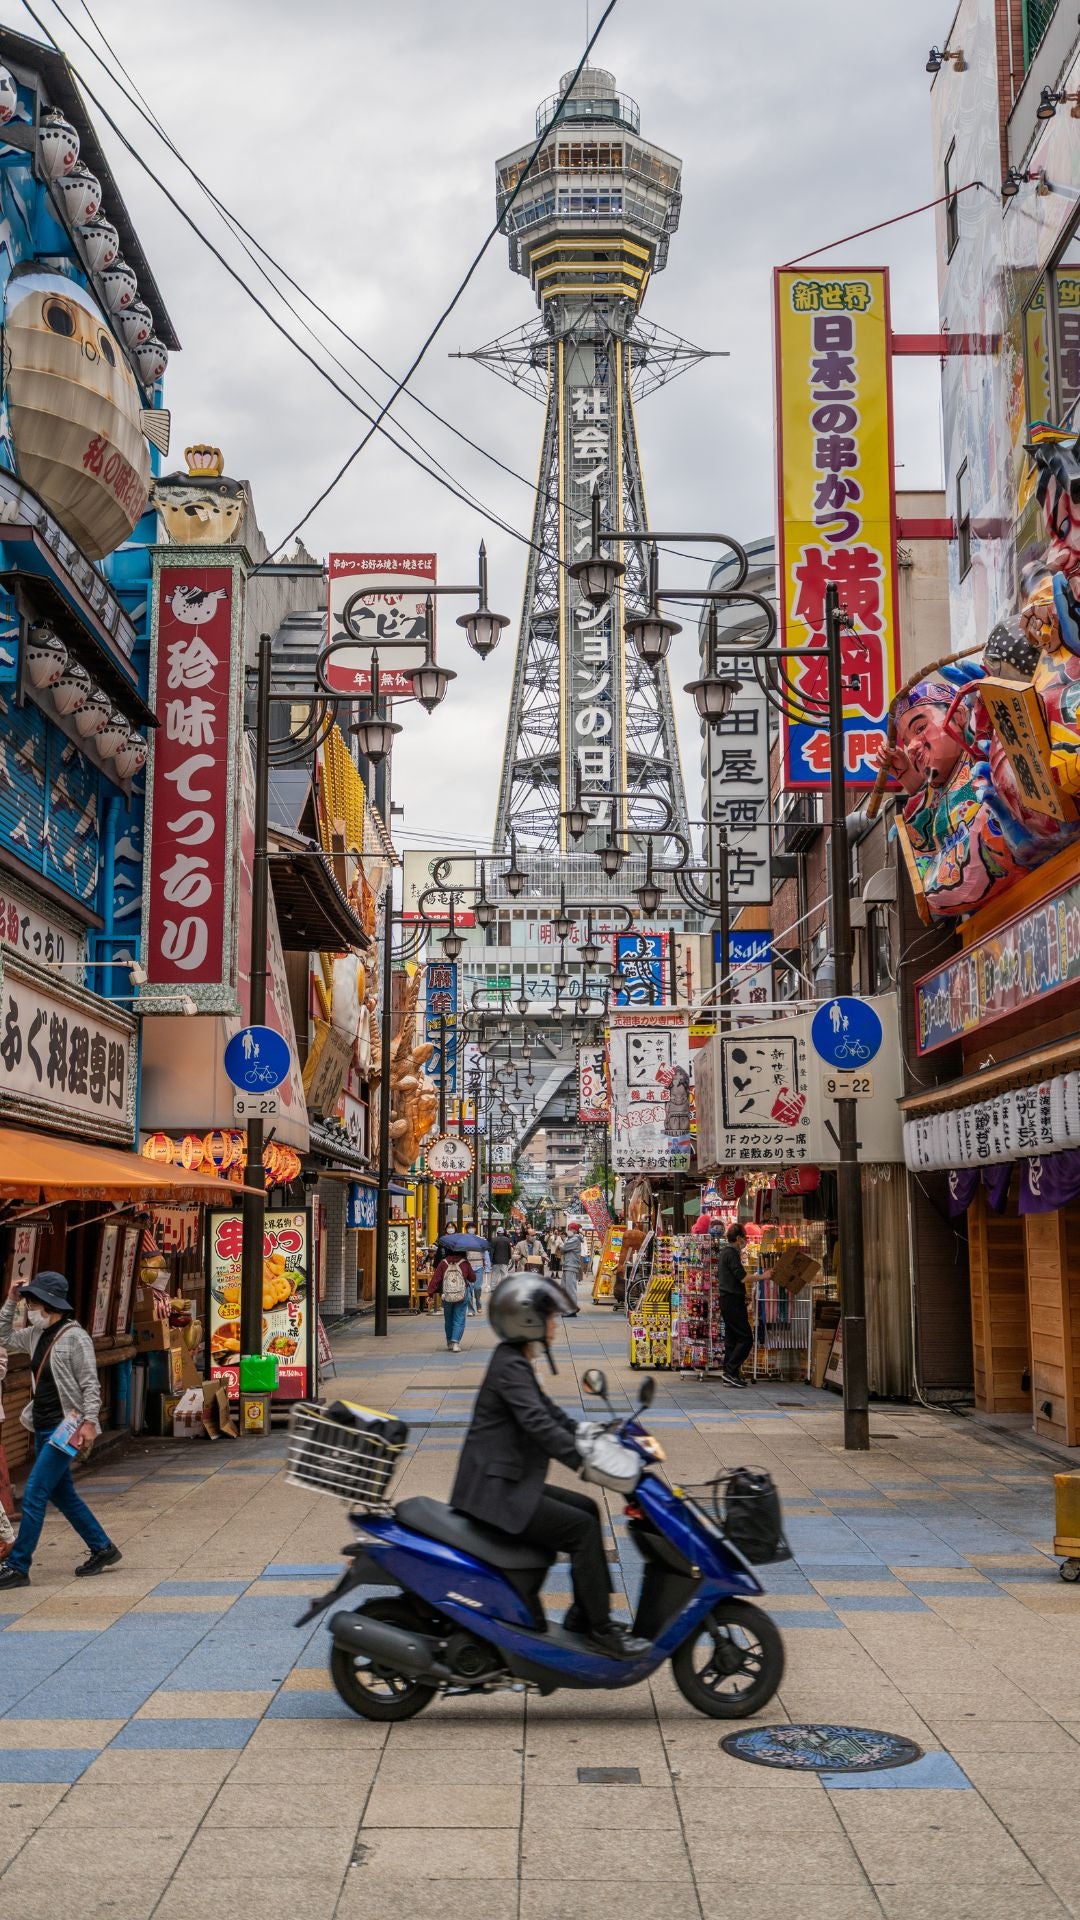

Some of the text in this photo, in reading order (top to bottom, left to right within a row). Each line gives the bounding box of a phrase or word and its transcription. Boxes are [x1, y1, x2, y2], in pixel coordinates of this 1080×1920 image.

[792, 280, 872, 312] 新世界
[810, 315, 858, 543] 日本一の串かつ
[572, 387, 612, 827] 社会イノベションの日立
[795, 546, 884, 720] 横綱
[353, 672, 409, 687] 年無休
[159, 635, 217, 972] 珍味てっちり
[0, 994, 125, 1110] ふぐ料理専門
[725, 1133, 807, 1145] 1F カウンター席
[725, 1147, 808, 1159] 2F 座敷あります
